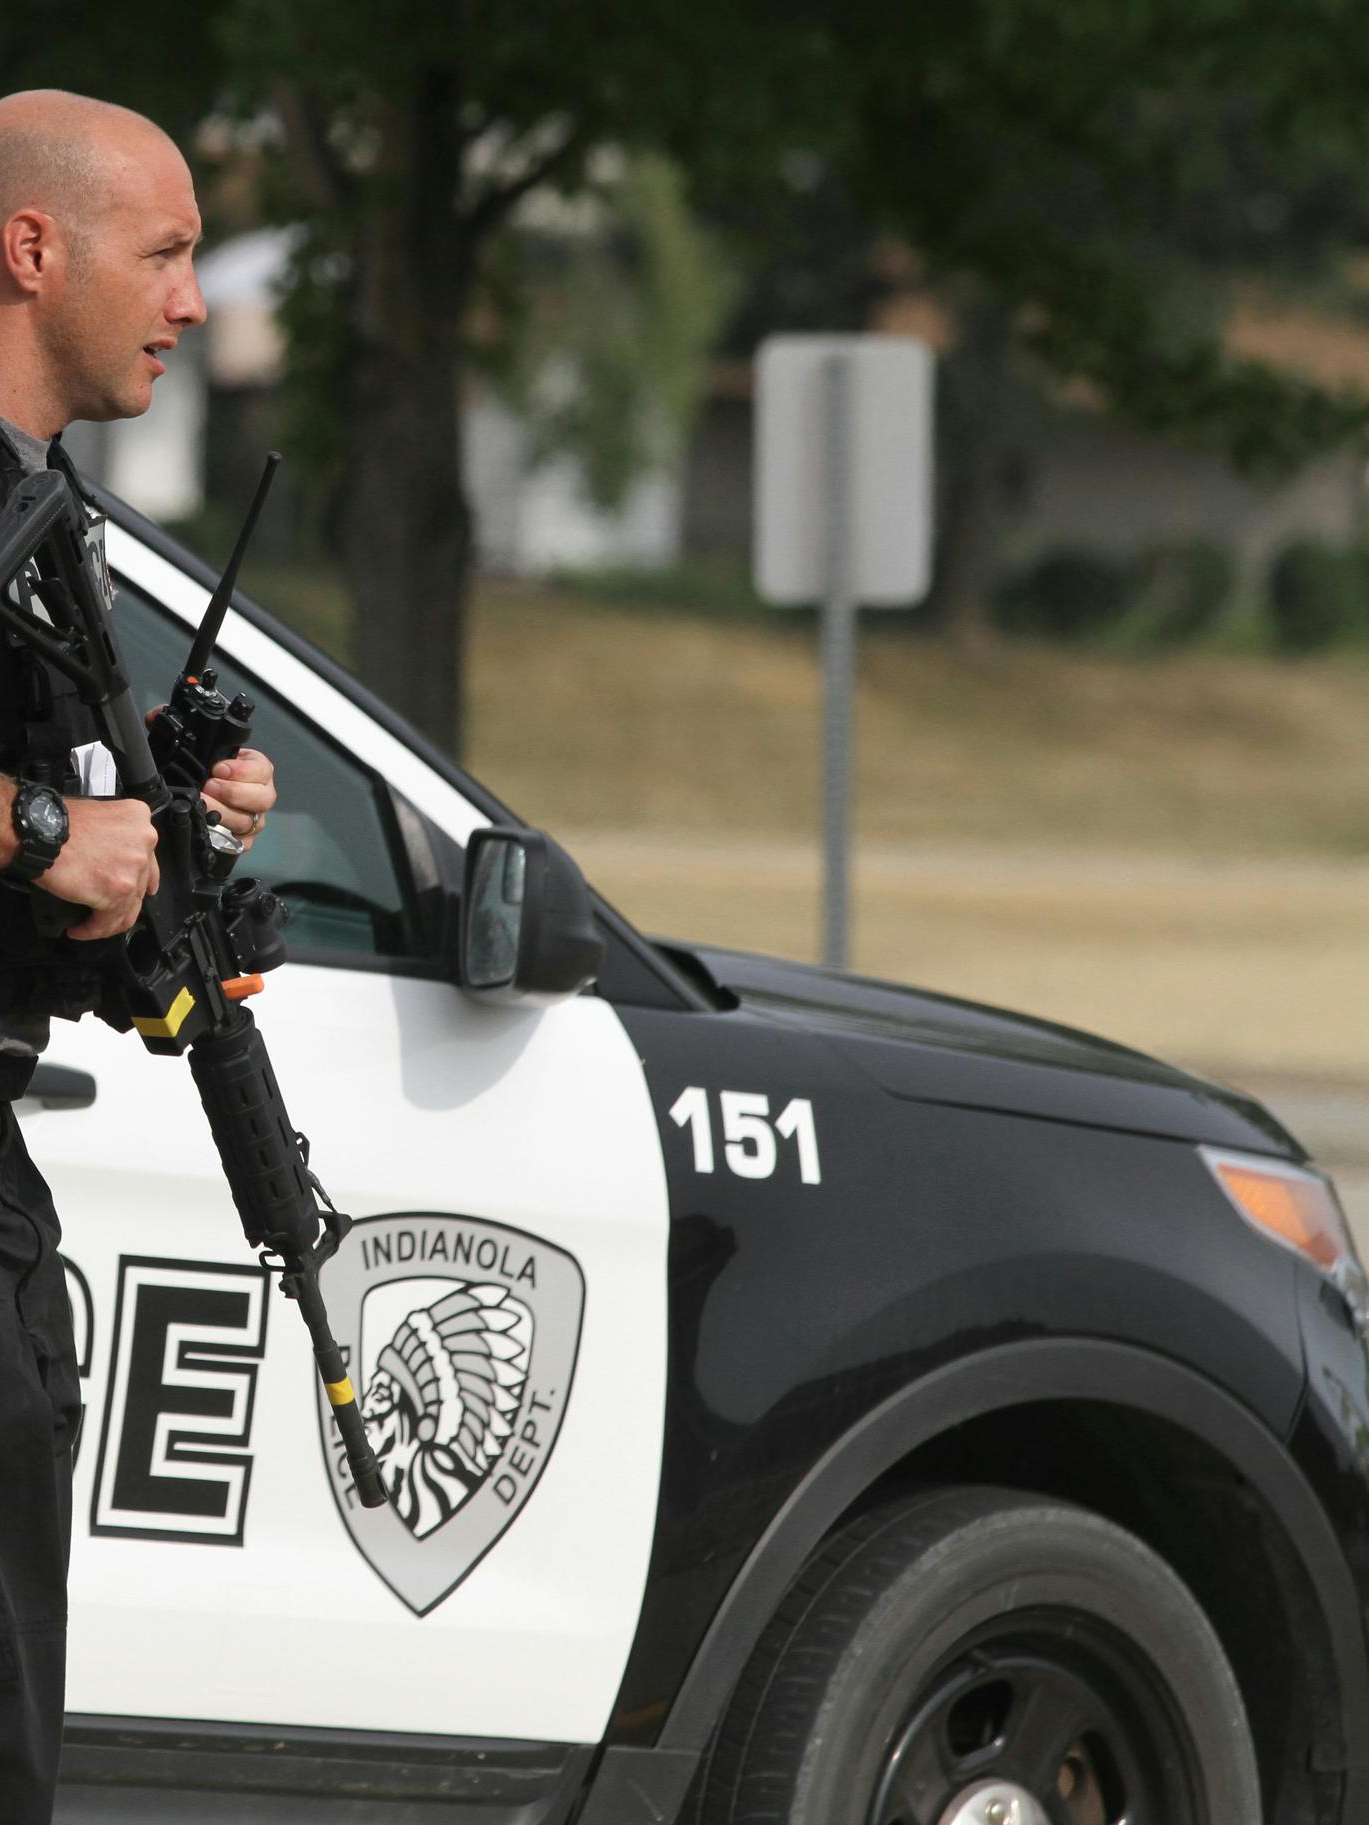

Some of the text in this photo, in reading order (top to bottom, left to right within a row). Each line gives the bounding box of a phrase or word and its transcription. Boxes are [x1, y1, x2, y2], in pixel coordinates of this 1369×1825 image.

[668, 1085, 821, 1185] 151
[361, 1229, 536, 1289] INDIANOLA
[492, 1387, 556, 1506] DEPT.
